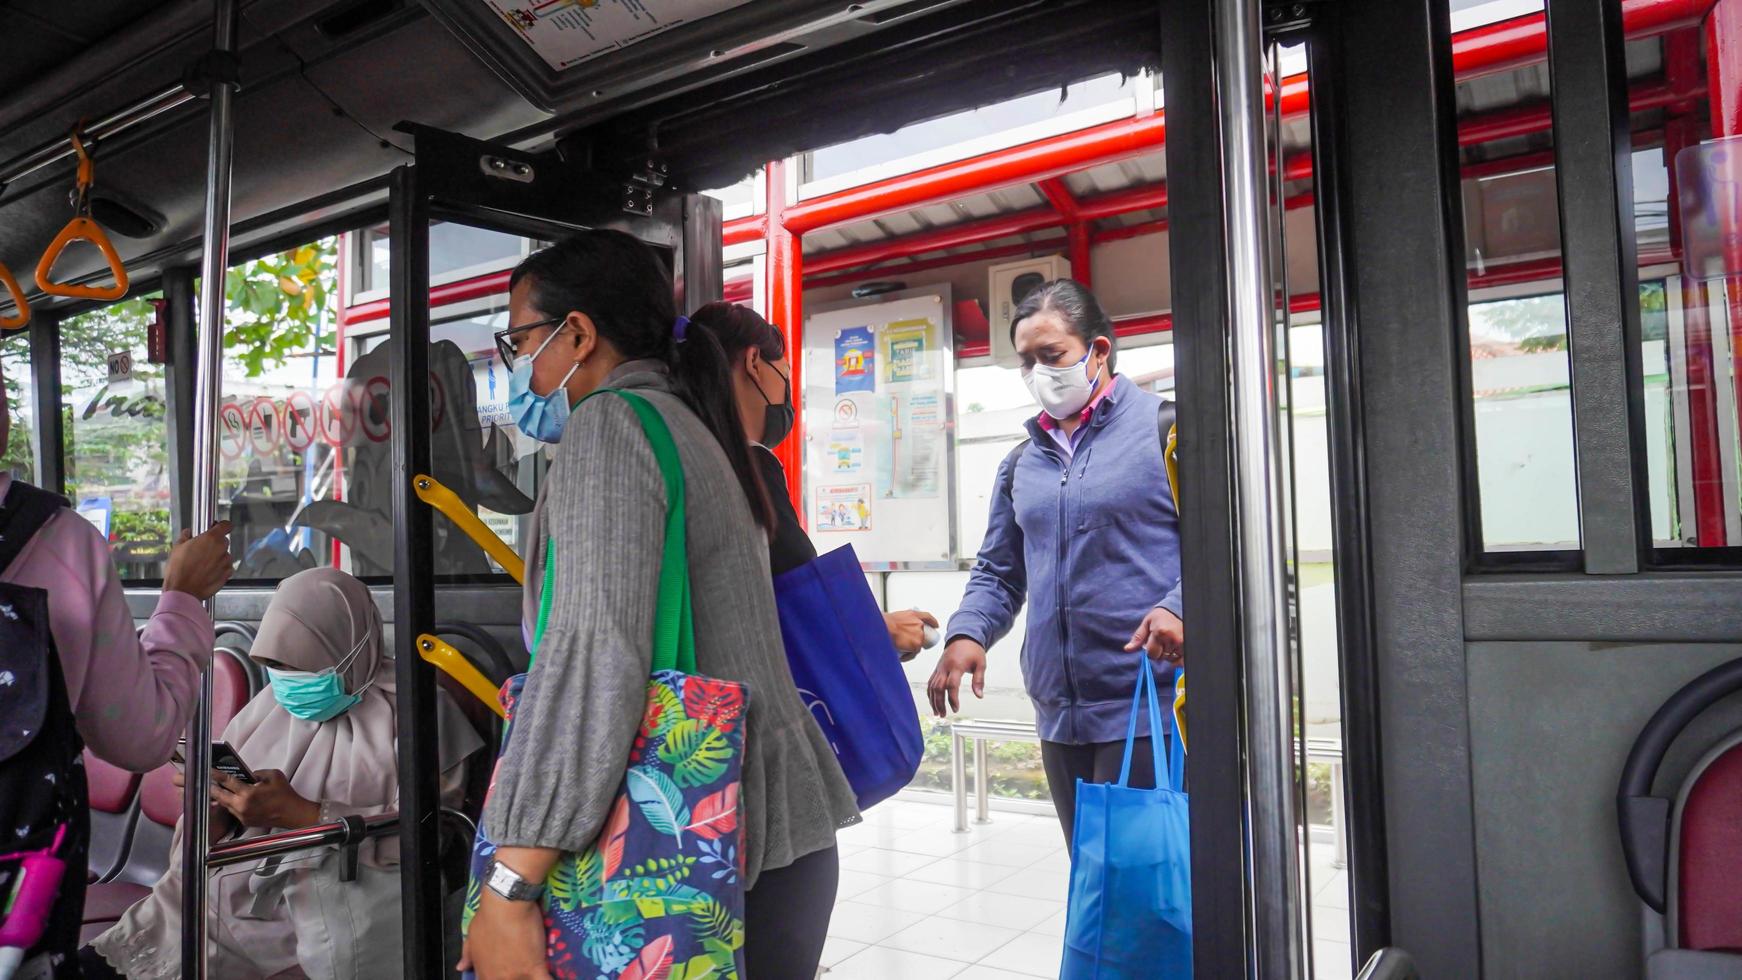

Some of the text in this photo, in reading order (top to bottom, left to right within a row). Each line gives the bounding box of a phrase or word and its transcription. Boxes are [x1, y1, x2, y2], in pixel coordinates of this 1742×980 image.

[110, 359, 119, 375] NO
[477, 403, 504, 413] ANGKU
[481, 412, 511, 424] PRIORIT
